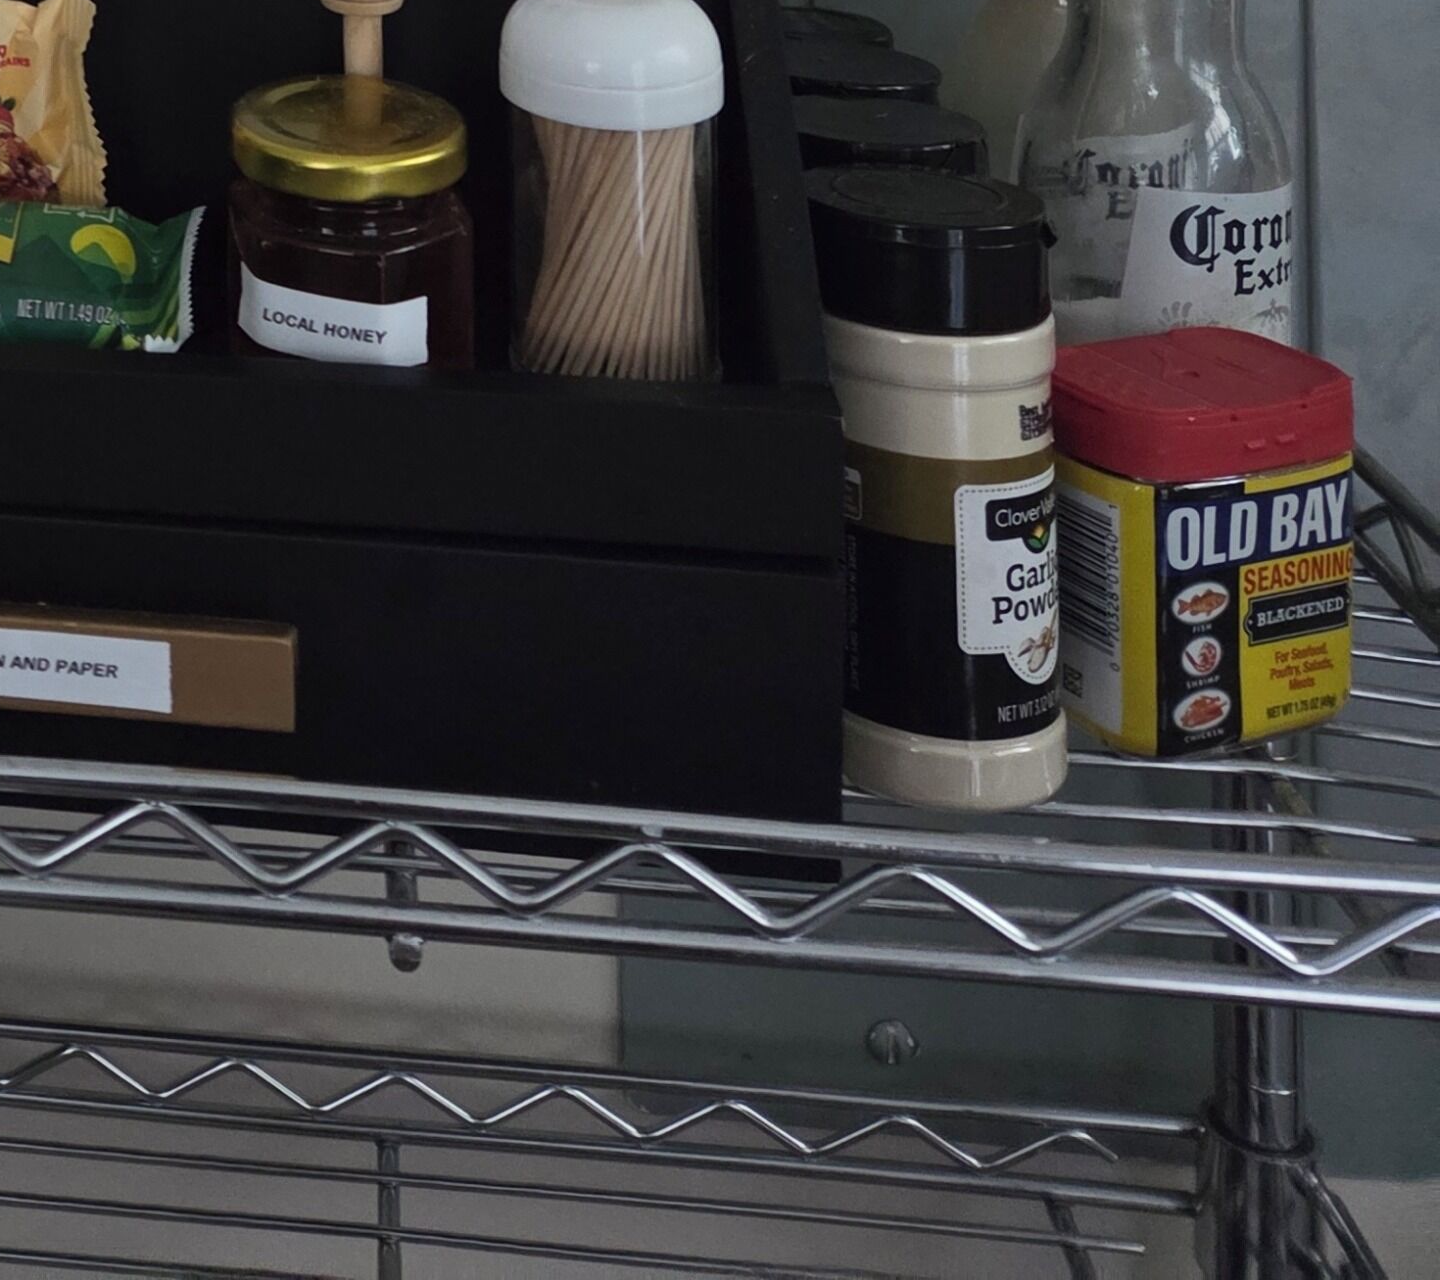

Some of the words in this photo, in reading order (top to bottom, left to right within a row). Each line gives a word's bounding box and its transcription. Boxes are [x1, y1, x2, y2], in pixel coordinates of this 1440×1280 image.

[17, 298, 42, 318] NET
[44, 301, 65, 320] WT
[96, 305, 113, 325] OZ
[262, 308, 318, 333] LOCAL
[324, 323, 387, 344] HONEY
[995, 506, 1040, 528] Clover
[1166, 500, 1258, 571] OLD
[1270, 478, 1349, 553] BAY
[1106, 533, 1119, 584] 01040
[1244, 547, 1354, 595] SEASONING
[1257, 596, 1345, 627] BLACKENED
[1192, 624, 1213, 634] FISH
[10, 655, 50, 673] AND
[56, 659, 119, 679] PAPER
[1186, 675, 1220, 690] SHRIMP
[998, 704, 1017, 724] NET
[1019, 701, 1034, 720] WT
[1184, 728, 1224, 744] CHICKEN
